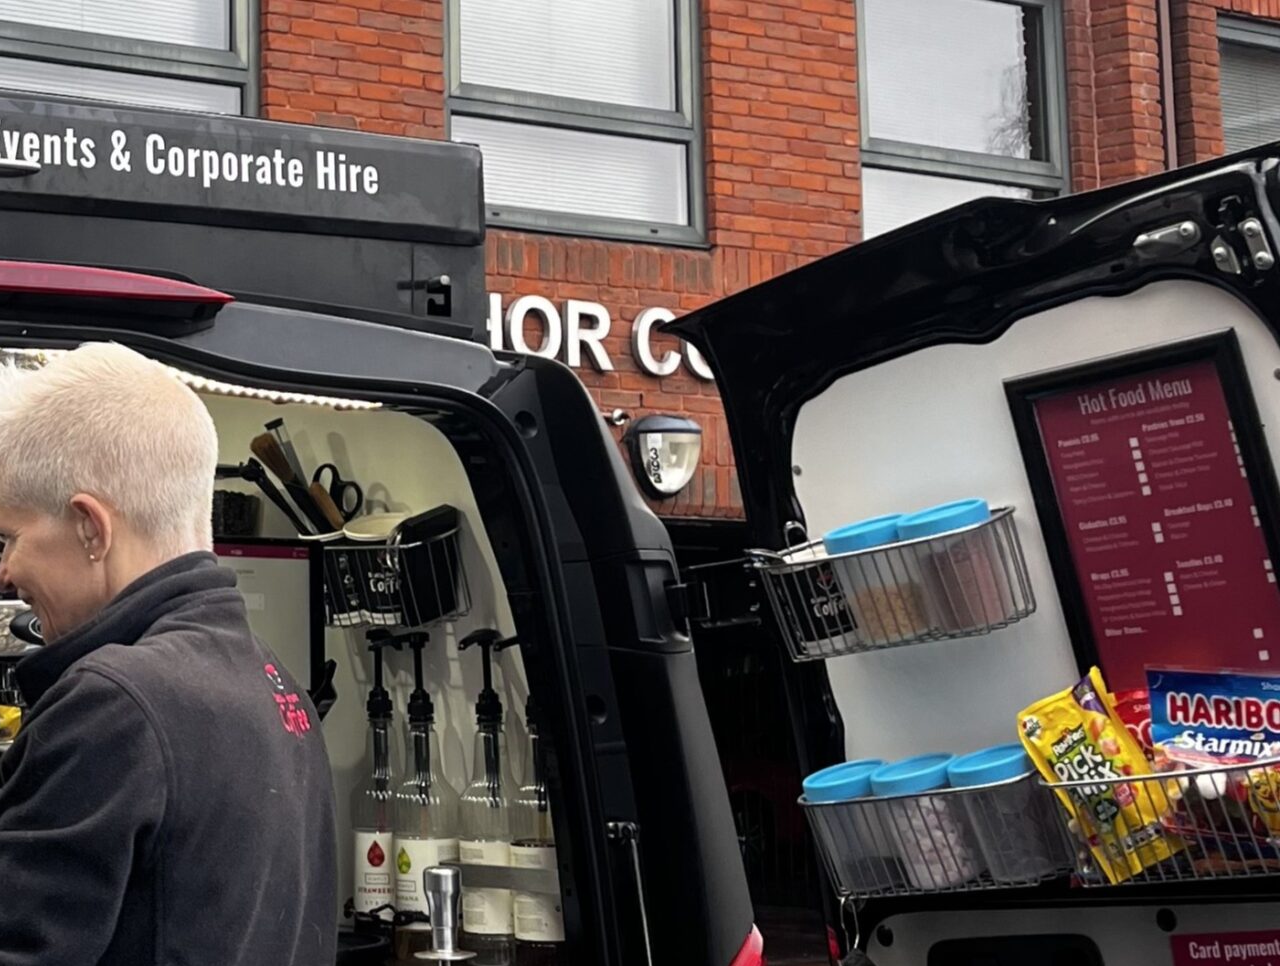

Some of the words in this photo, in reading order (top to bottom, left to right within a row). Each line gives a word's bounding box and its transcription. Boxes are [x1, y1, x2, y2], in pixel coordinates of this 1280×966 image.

[110, 130, 132, 173] &
[145, 134, 304, 188] Corporate
[316, 151, 379, 194] Hire
[1078, 394, 1107, 415] Hot
[1109, 386, 1146, 409] Food
[1148, 379, 1193, 406] Menu
[1179, 730, 1277, 758] Starmix
[1055, 746, 1103, 781] Pick
[1188, 941, 1221, 959] Card
